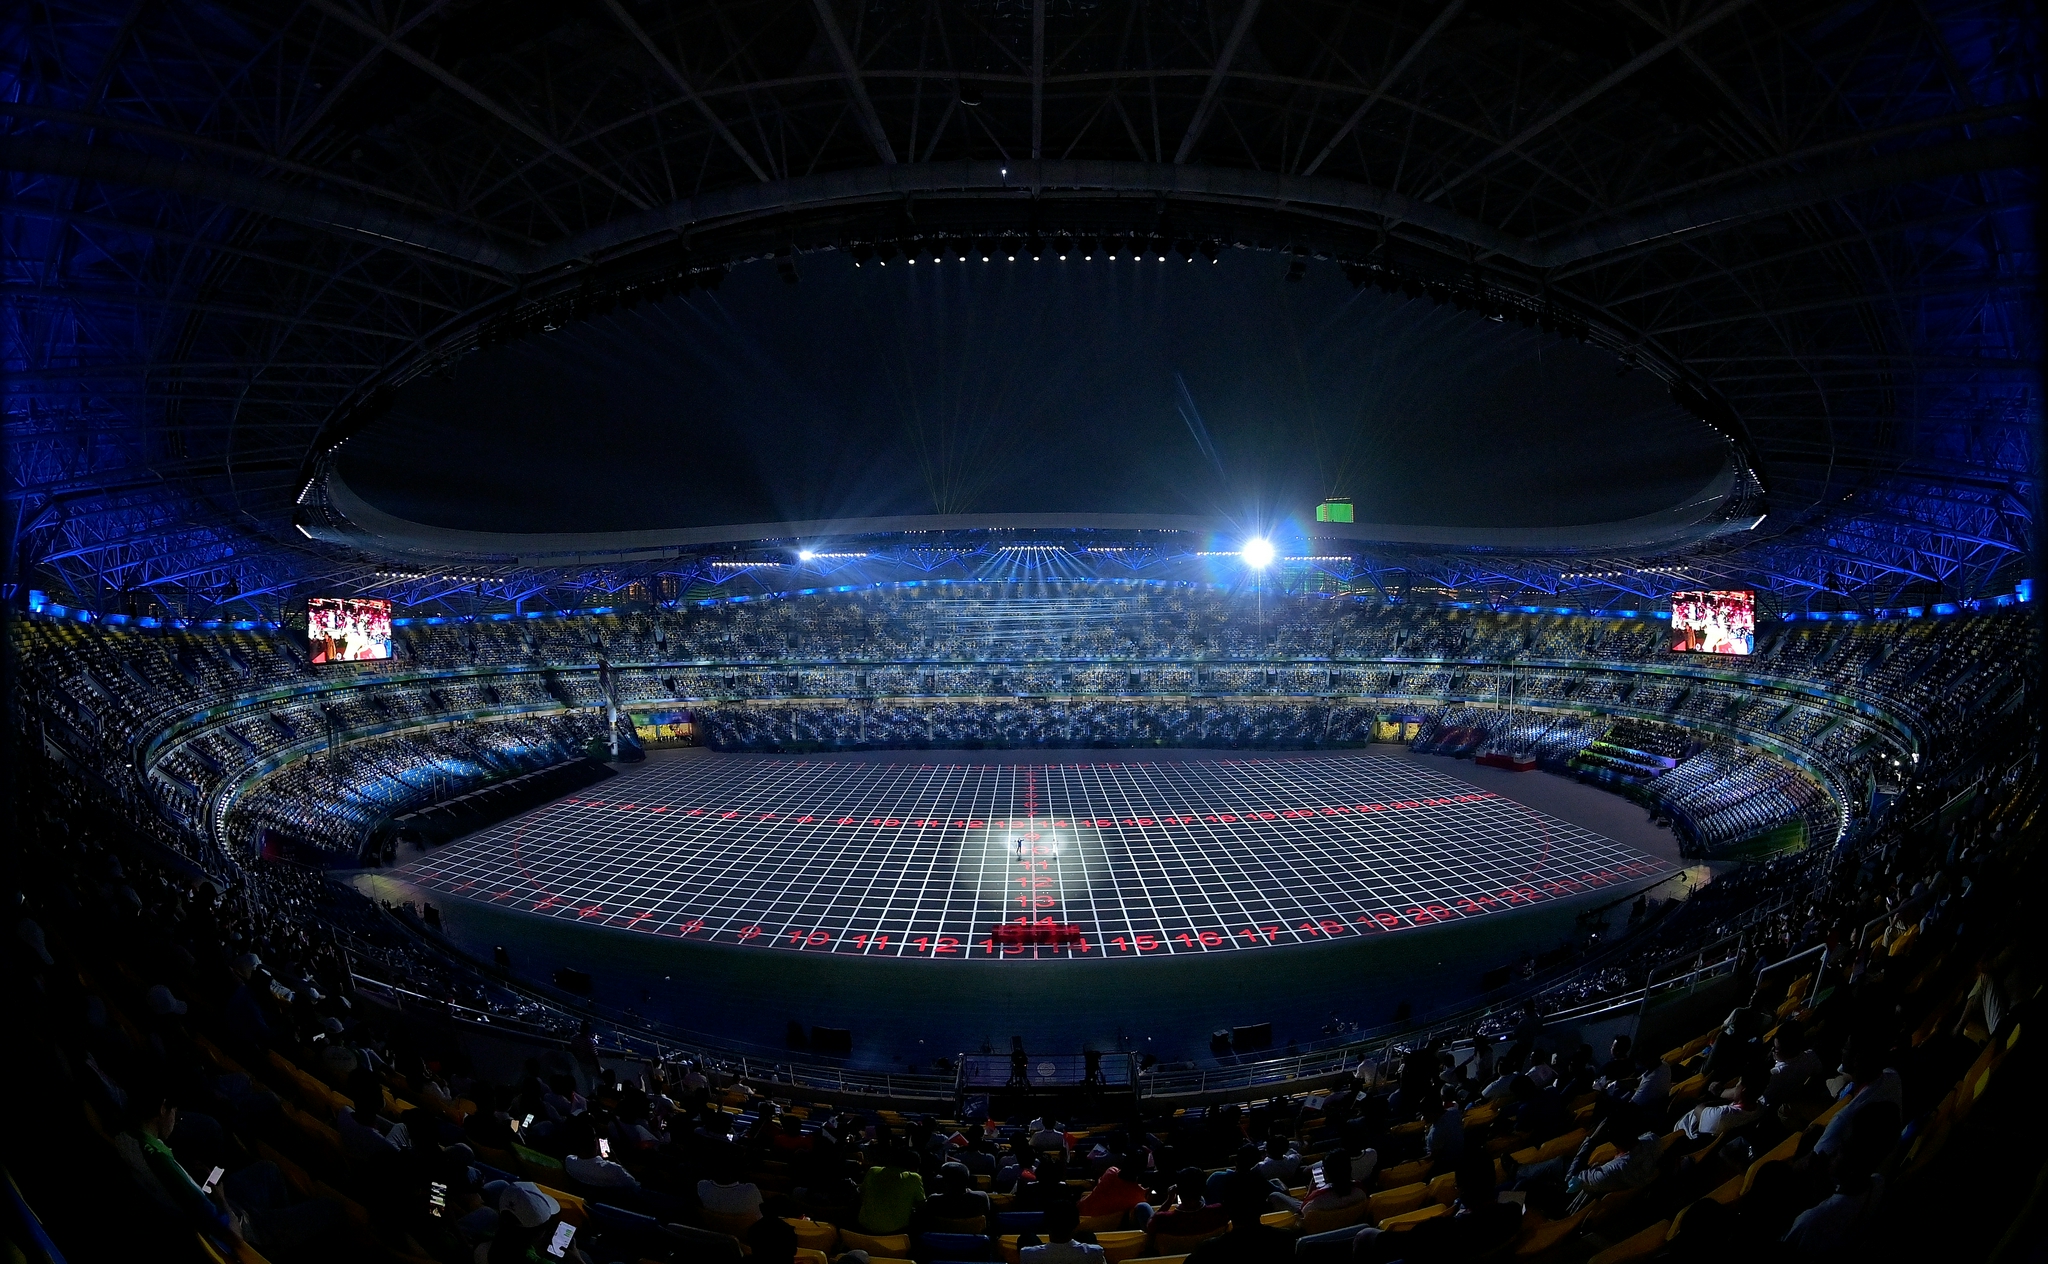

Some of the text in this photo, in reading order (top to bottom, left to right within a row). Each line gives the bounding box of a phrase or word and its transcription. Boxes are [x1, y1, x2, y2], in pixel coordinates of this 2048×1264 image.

[871, 818, 900, 827] 10
[913, 819, 939, 828] 11
[953, 820, 984, 828] 12
[995, 820, 1025, 828] 13
[1037, 820, 1068, 828] 14
[1081, 819, 1112, 827] 15
[1123, 818, 1154, 826] 16
[1165, 816, 1193, 825] 17
[1205, 814, 1237, 823] 18
[1246, 812, 1276, 820] 19
[1282, 809, 1314, 819] 20
[1321, 806, 1350, 815] 21
[1355, 804, 1387, 812] 22
[1390, 801, 1420, 809] 23
[1019, 861, 1048, 870] 11
[1015, 877, 1053, 887] 12
[1014, 895, 1054, 907] 13
[578, 905, 603, 917] 6
[628, 912, 653, 923] 7
[679, 919, 704, 933] 8
[736, 925, 762, 939] 9
[787, 930, 831, 946] 10
[852, 935, 890, 951] 11
[913, 937, 959, 953] 12
[1111, 935, 1159, 951] 15
[1175, 931, 1223, 947] 16
[1239, 925, 1279, 942] 17
[1299, 920, 1345, 936] 18
[1356, 912, 1399, 929] 19
[1406, 905, 1449, 921] 20
[1457, 896, 1497, 911] 21
[1500, 887, 1542, 903] 22
[1544, 879, 1581, 894] 23
